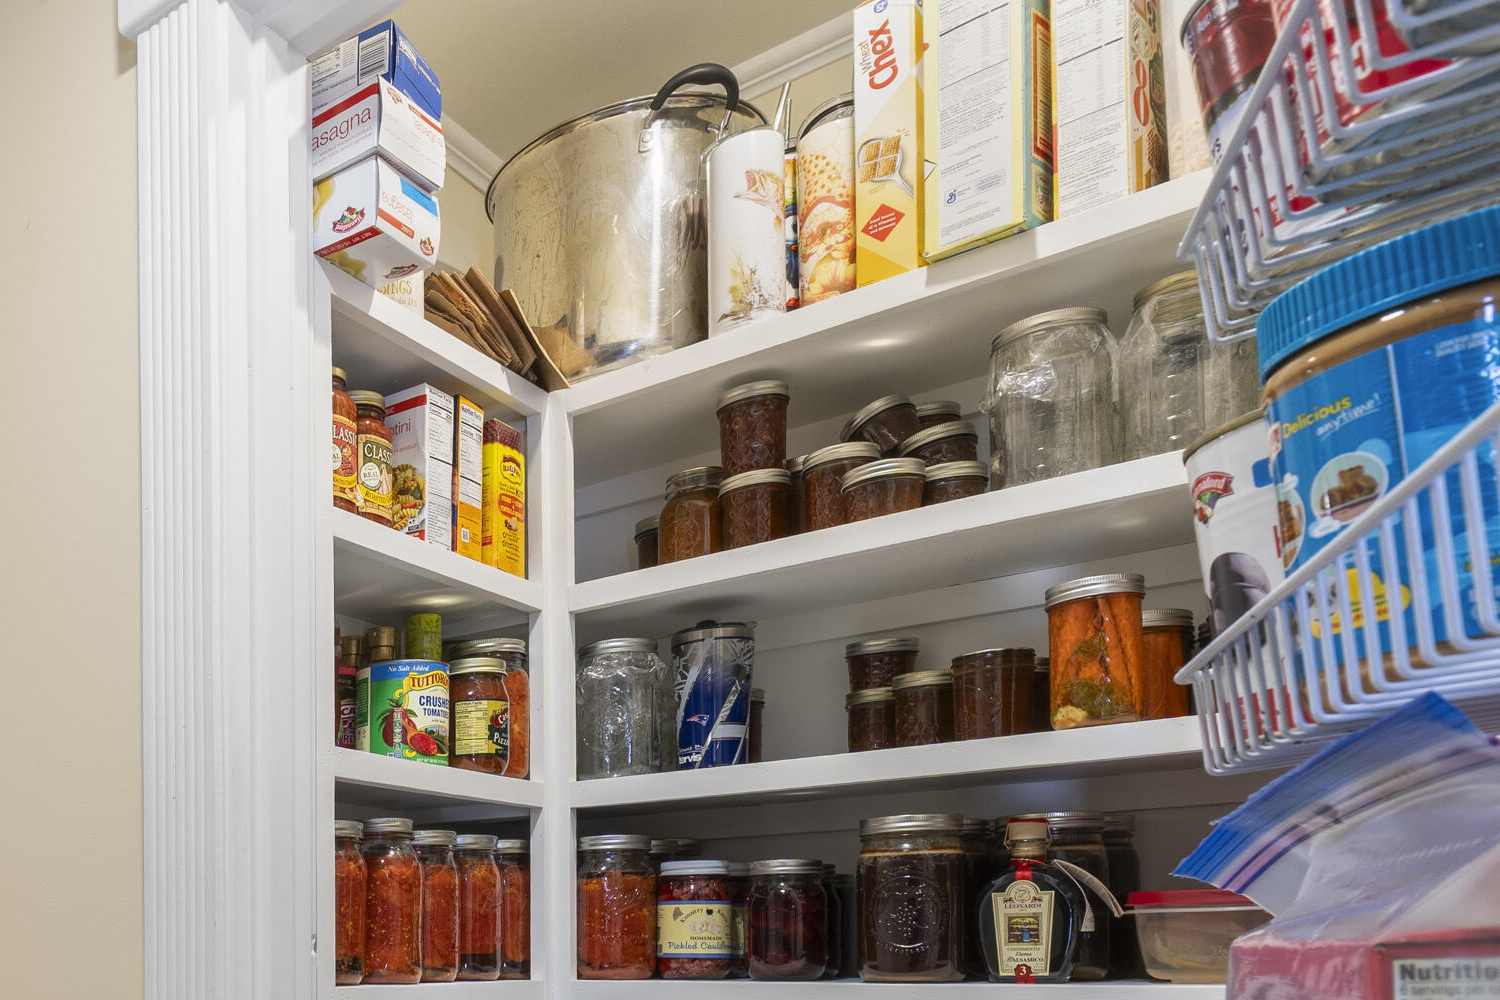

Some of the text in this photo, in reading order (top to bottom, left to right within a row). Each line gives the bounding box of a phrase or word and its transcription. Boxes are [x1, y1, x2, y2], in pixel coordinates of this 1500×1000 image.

[858, 40, 872, 76] Wheat
[868, 18, 899, 90] Chex
[1282, 395, 1352, 440] Delicious
[411, 664, 430, 672] Added
[668, 941, 698, 950] Pickled
